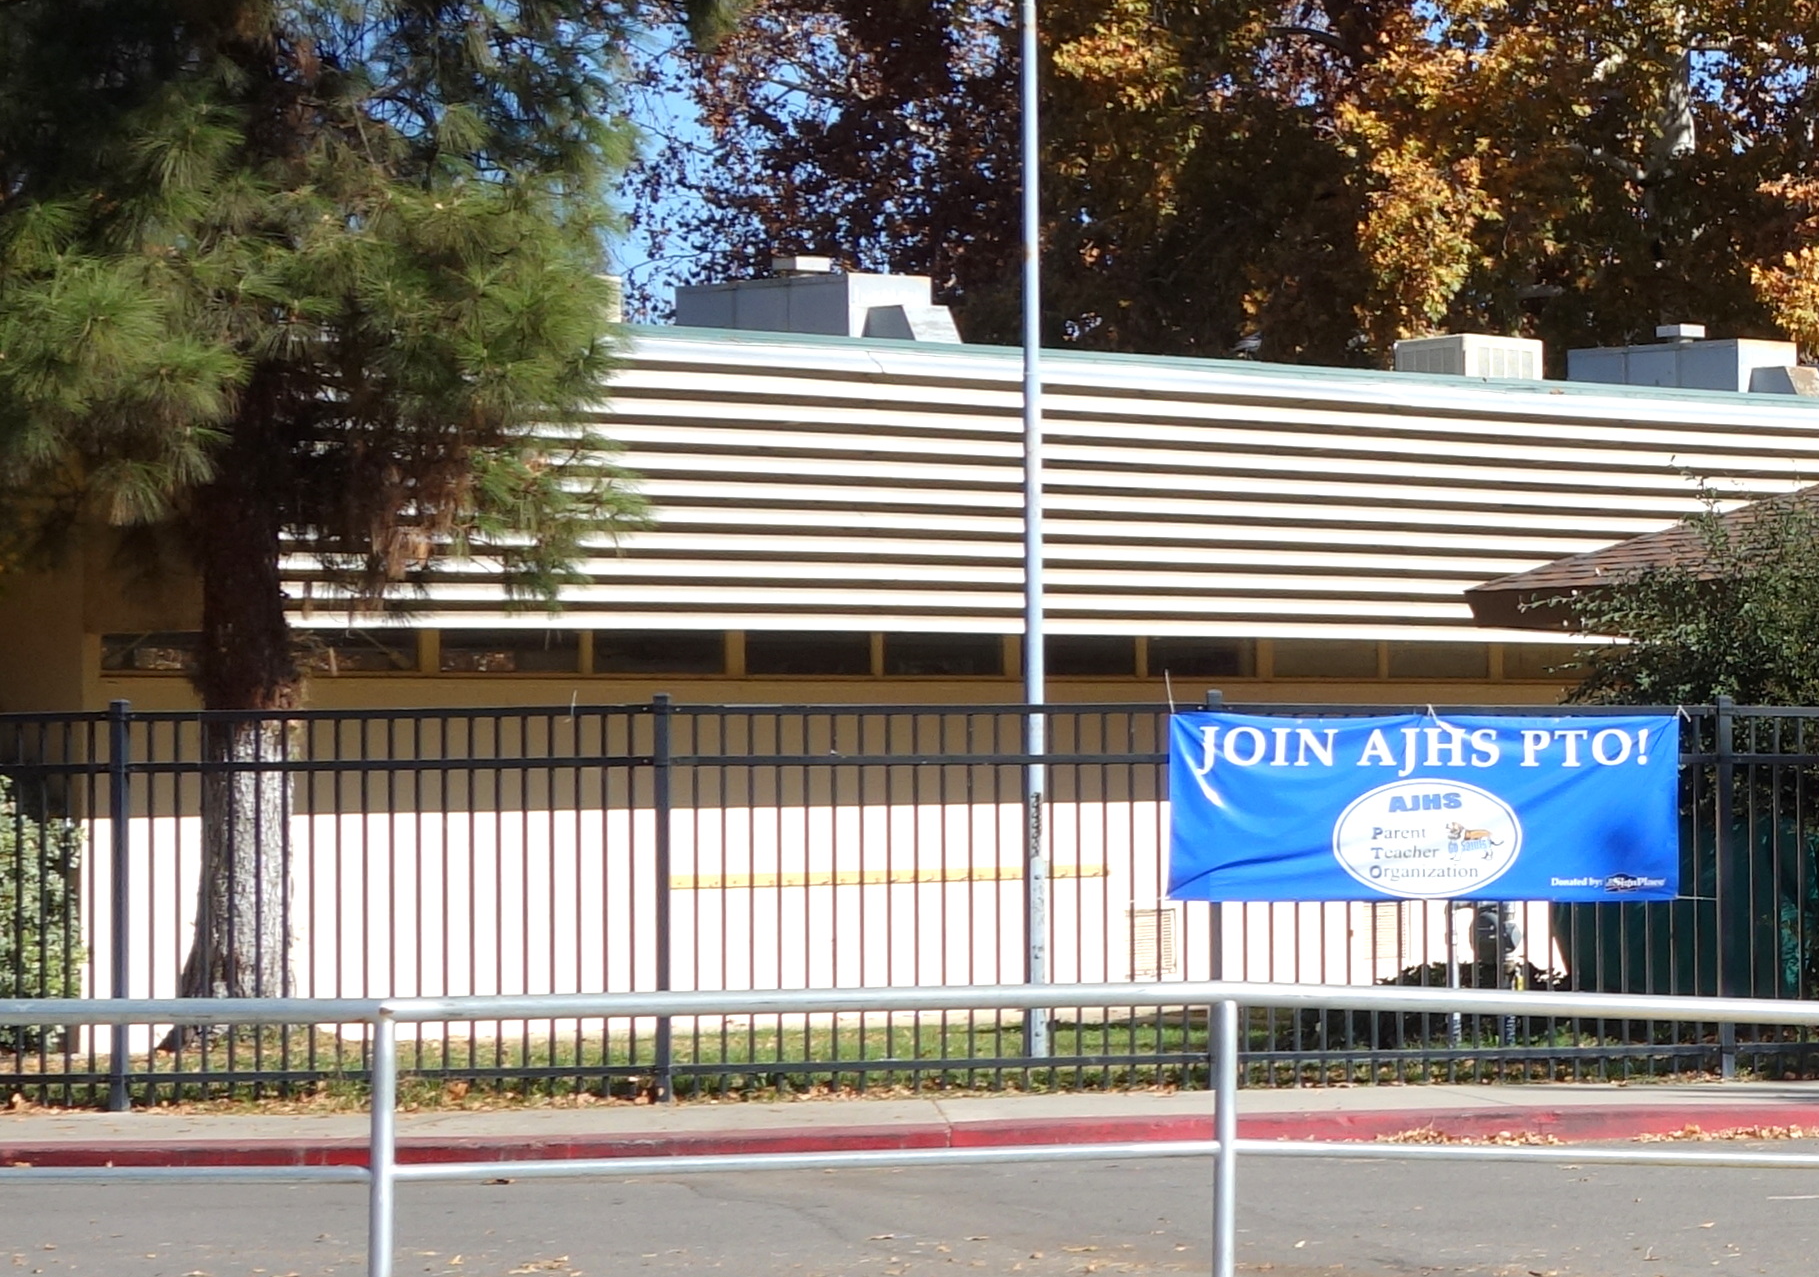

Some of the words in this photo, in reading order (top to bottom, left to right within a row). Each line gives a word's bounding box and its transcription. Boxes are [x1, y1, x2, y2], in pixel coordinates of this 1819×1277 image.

[1196, 726, 1339, 775] JOIN
[1356, 727, 1500, 776] AJHS
[1520, 728, 1649, 767] PTO!
[1388, 792, 1462, 813] AJHS
[1371, 827, 1426, 840] Parent
[1371, 845, 1440, 859] Teacher
[1369, 864, 1479, 882] Organization
[1551, 877, 1588, 887] Donated
